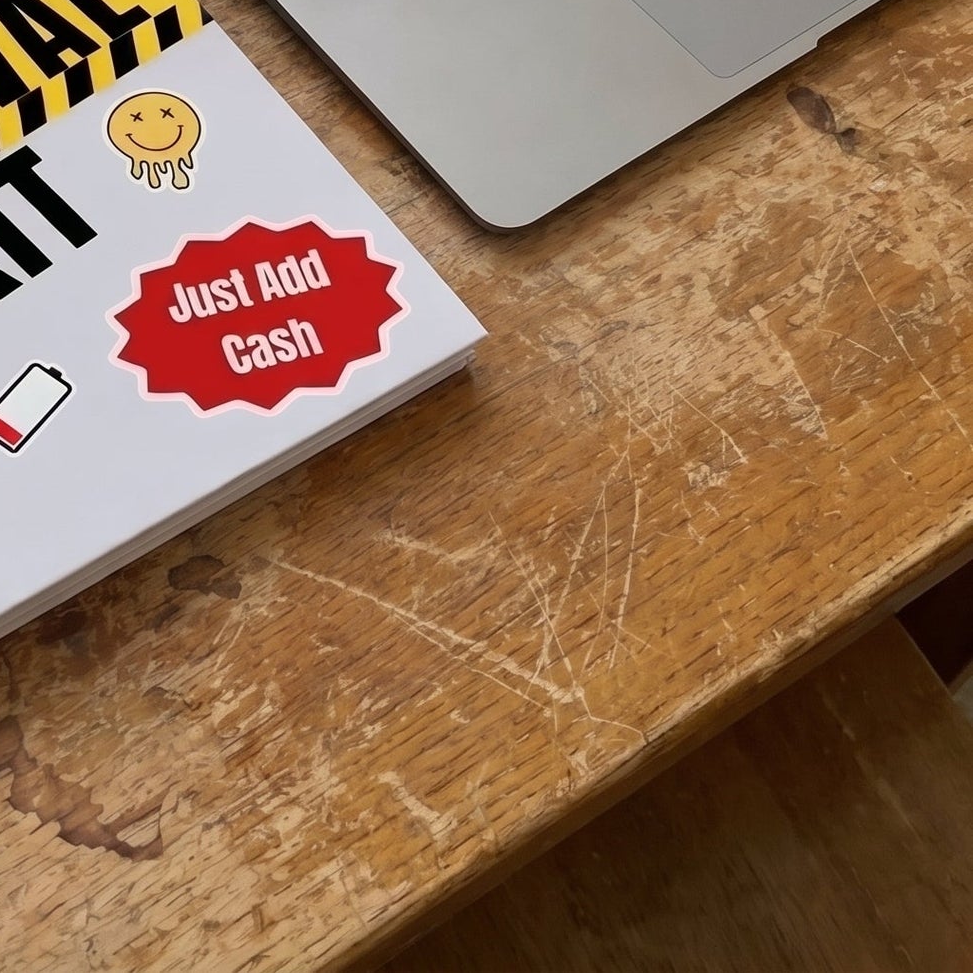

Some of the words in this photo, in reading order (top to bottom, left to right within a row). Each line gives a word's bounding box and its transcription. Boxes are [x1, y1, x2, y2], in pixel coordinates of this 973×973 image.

[167, 268, 255, 324] Just
[254, 248, 333, 303] Add
[220, 317, 325, 376] Cash
